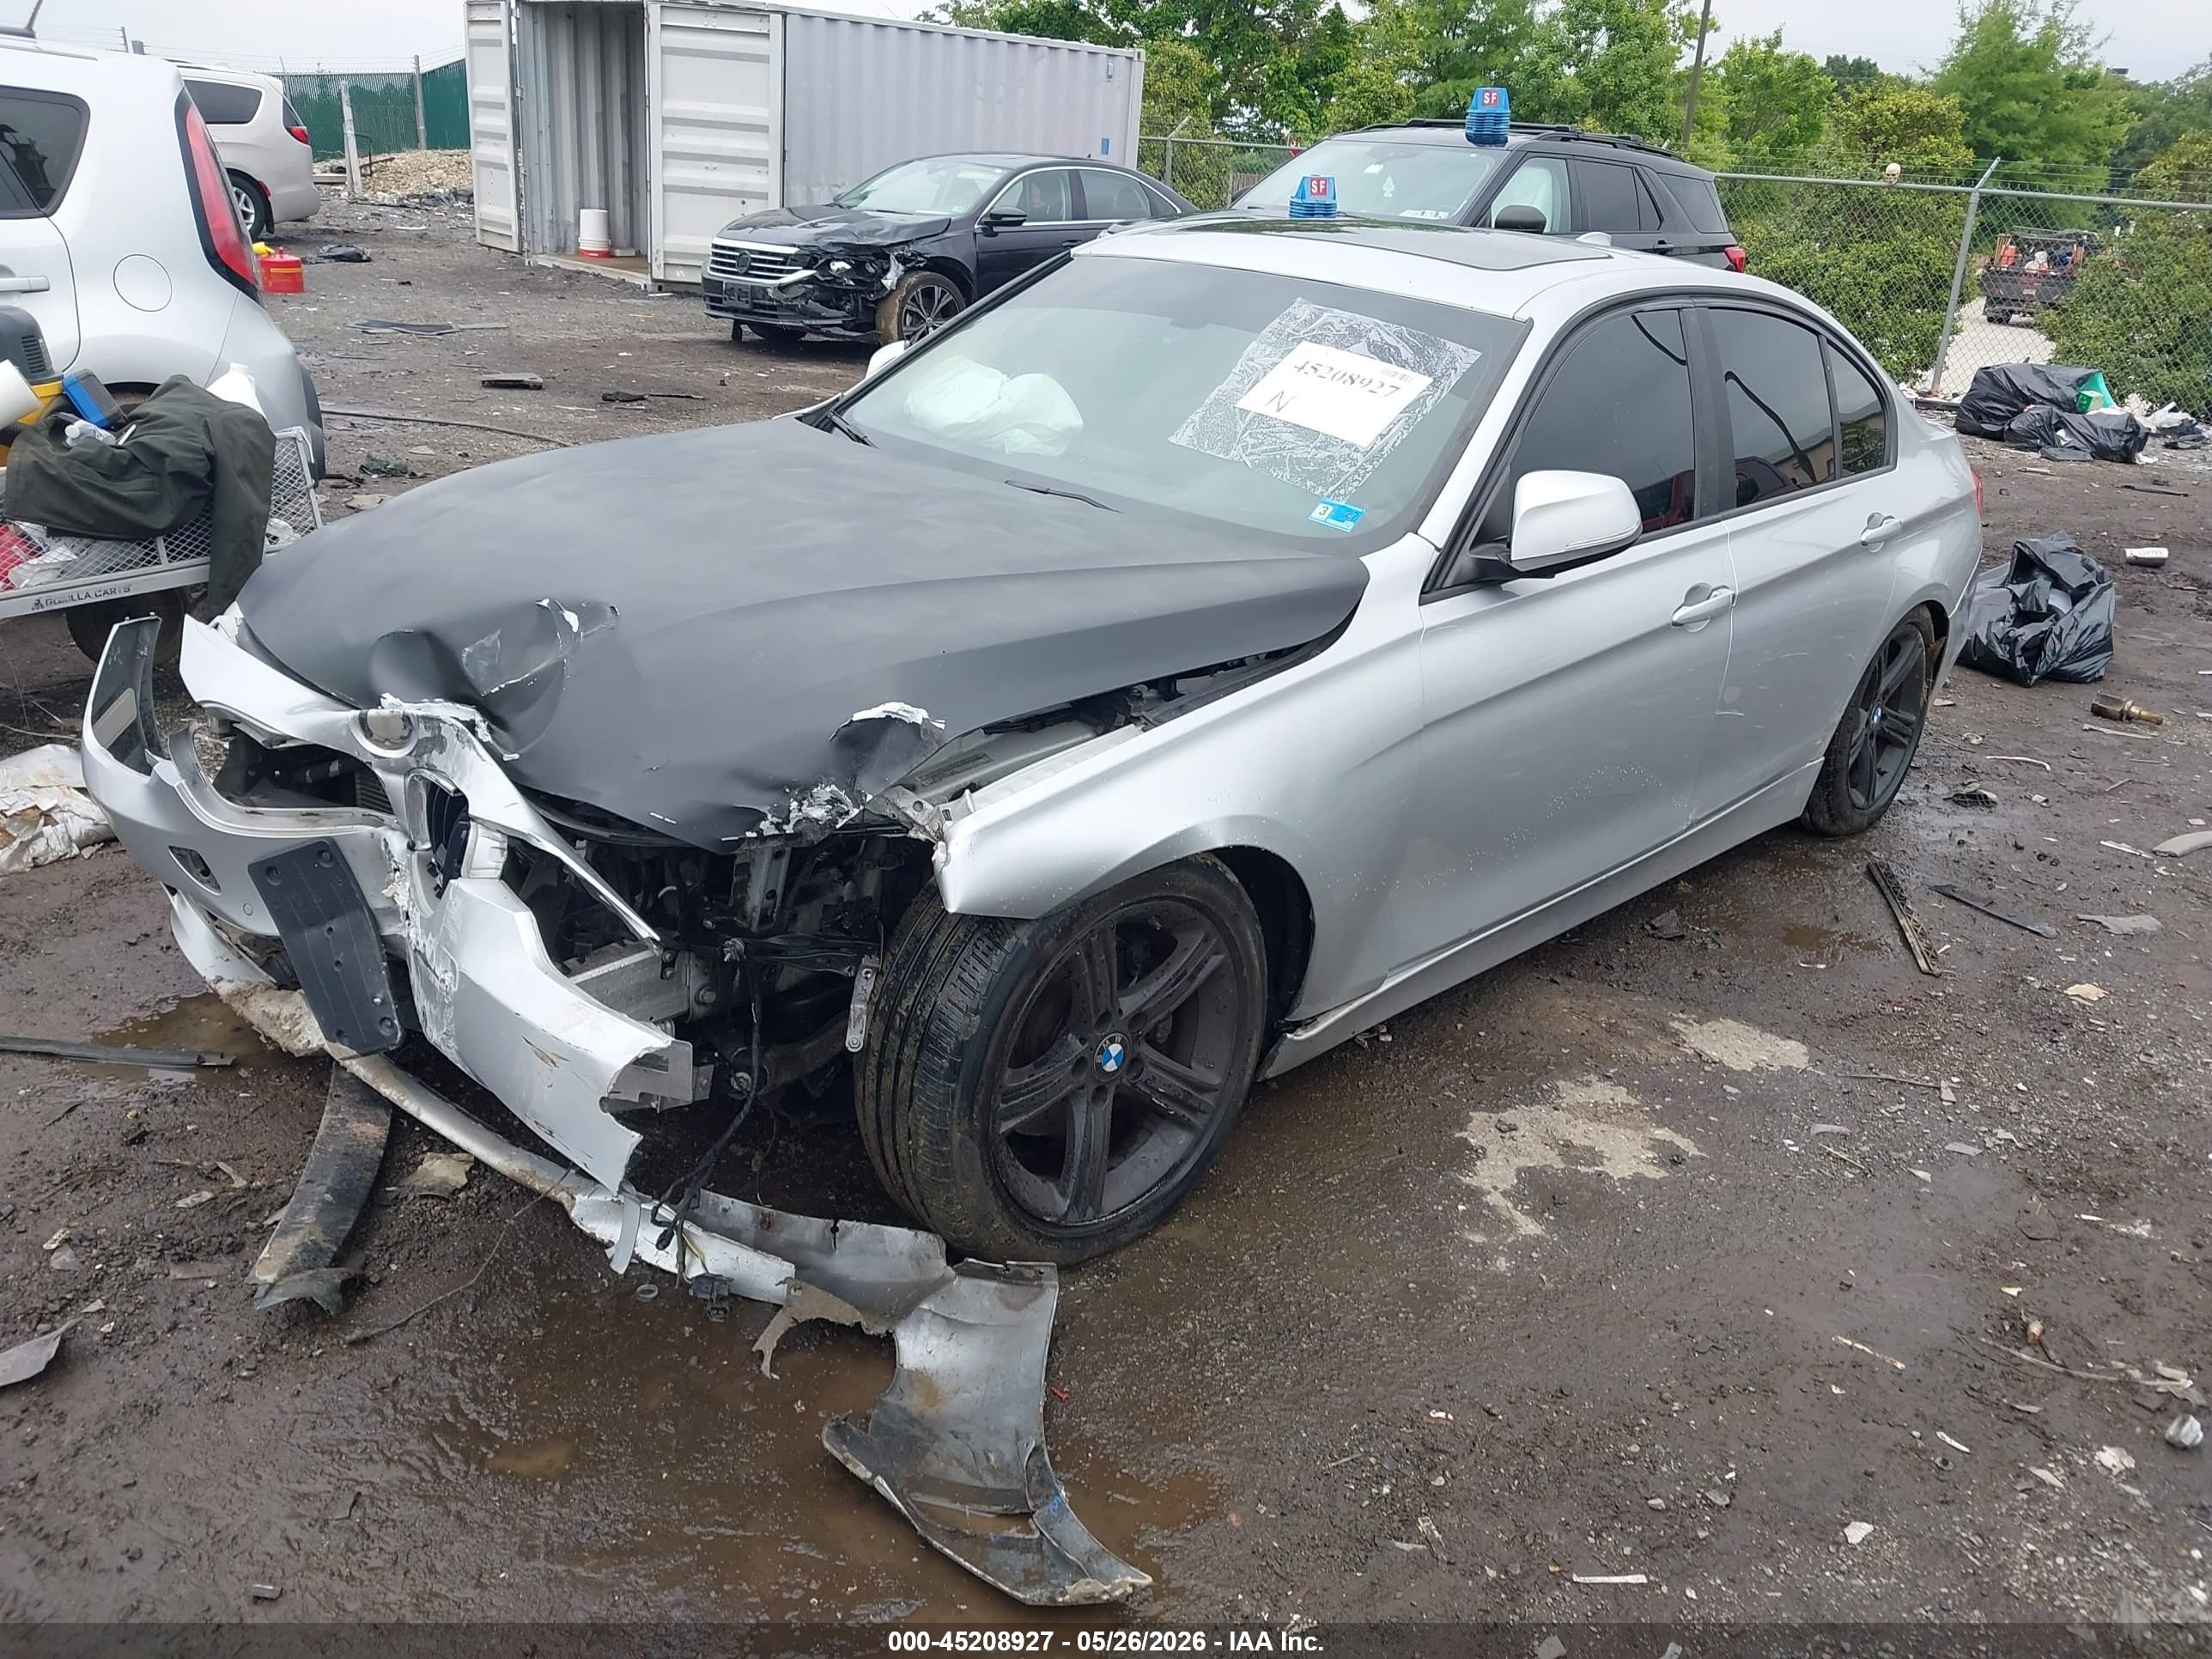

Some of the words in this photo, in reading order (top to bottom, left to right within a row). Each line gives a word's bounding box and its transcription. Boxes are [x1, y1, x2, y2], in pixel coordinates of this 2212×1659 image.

[1483, 92, 1498, 104] SF
[1311, 179, 1326, 193] SF
[1294, 361, 1401, 398] 45208927
[1264, 391, 1297, 413] N
[1318, 506, 1329, 516] 3
